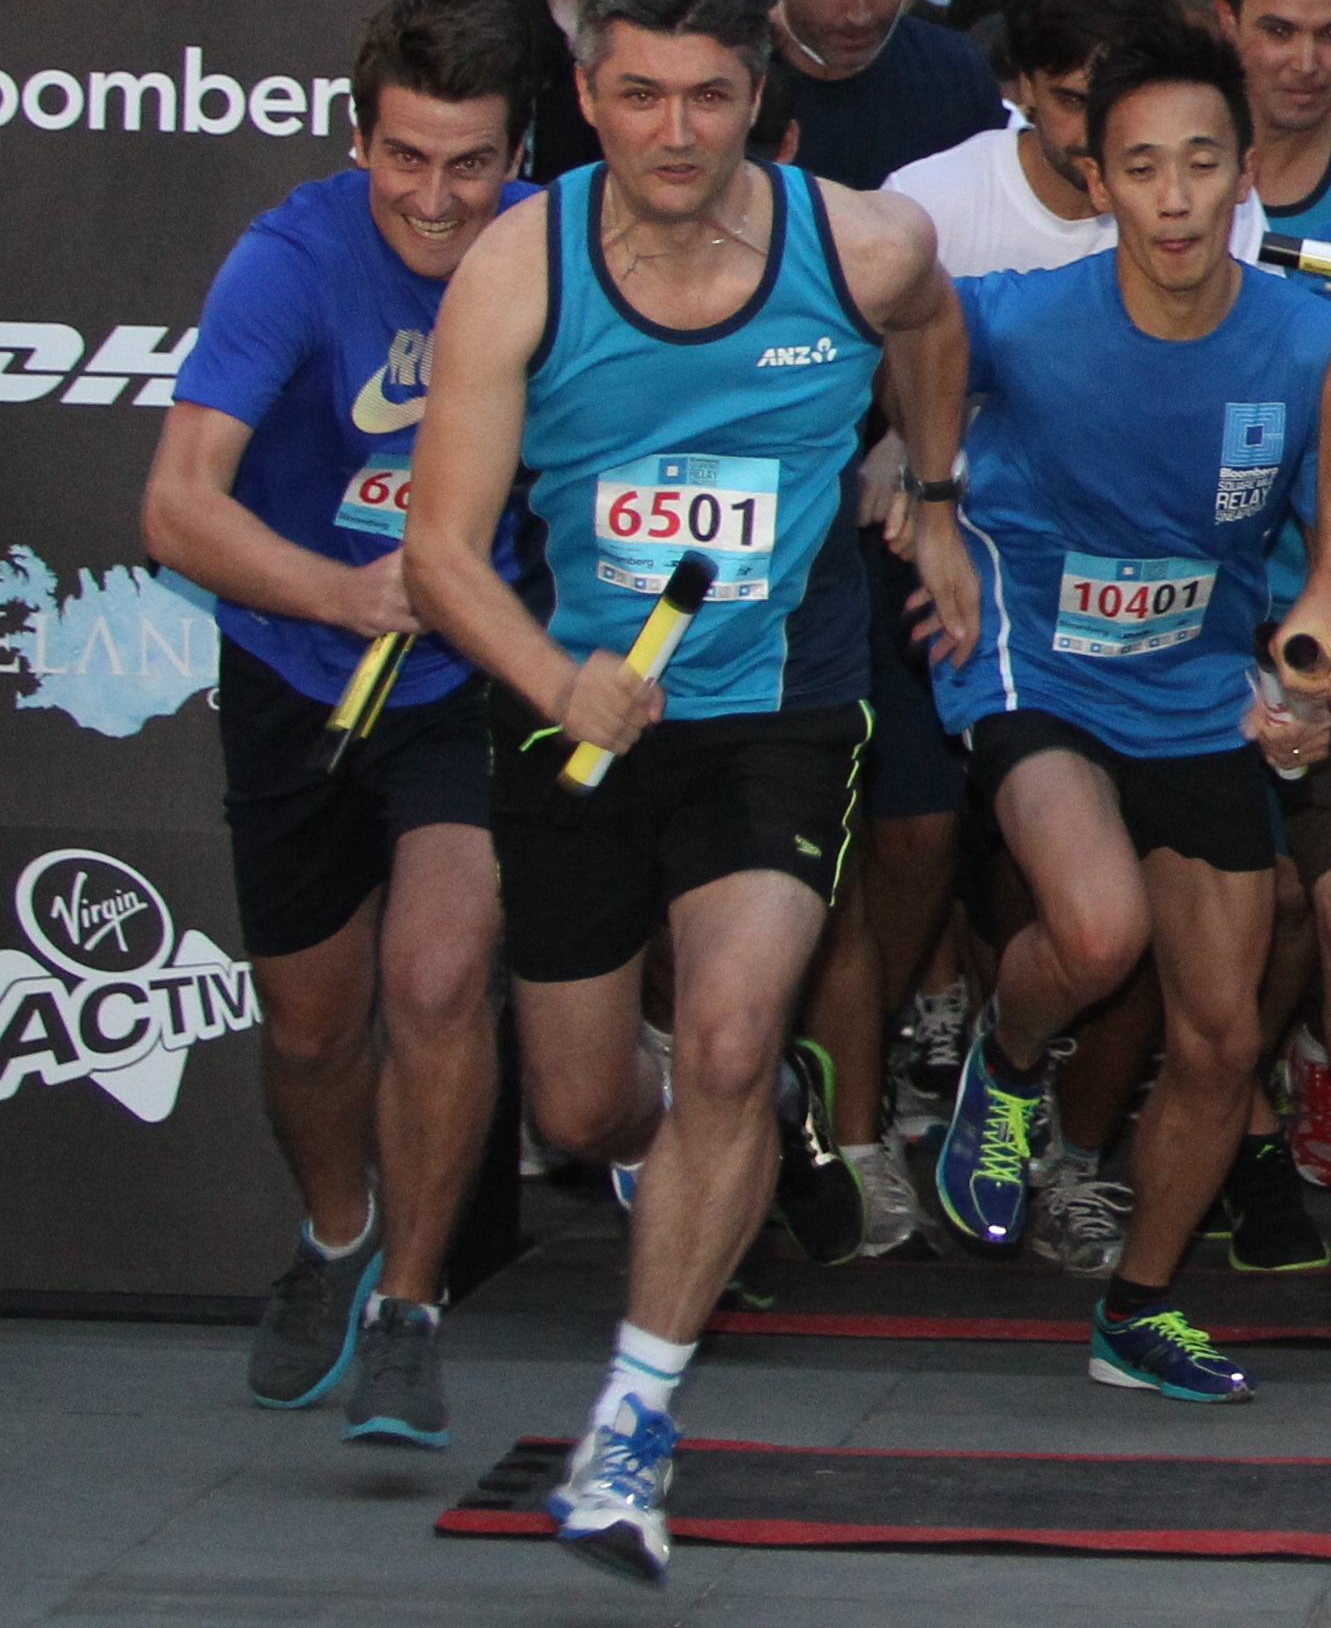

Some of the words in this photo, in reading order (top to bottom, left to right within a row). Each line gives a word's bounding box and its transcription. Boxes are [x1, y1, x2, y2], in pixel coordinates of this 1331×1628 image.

[0, 321, 200, 407] DH
[757, 345, 812, 368] ANZ
[608, 490, 757, 548] 6501
[1215, 484, 1272, 511] RELAY
[1073, 579, 1201, 620] 10401
[49, 870, 150, 953] Virgin
[0, 969, 253, 1081] ACTIV
